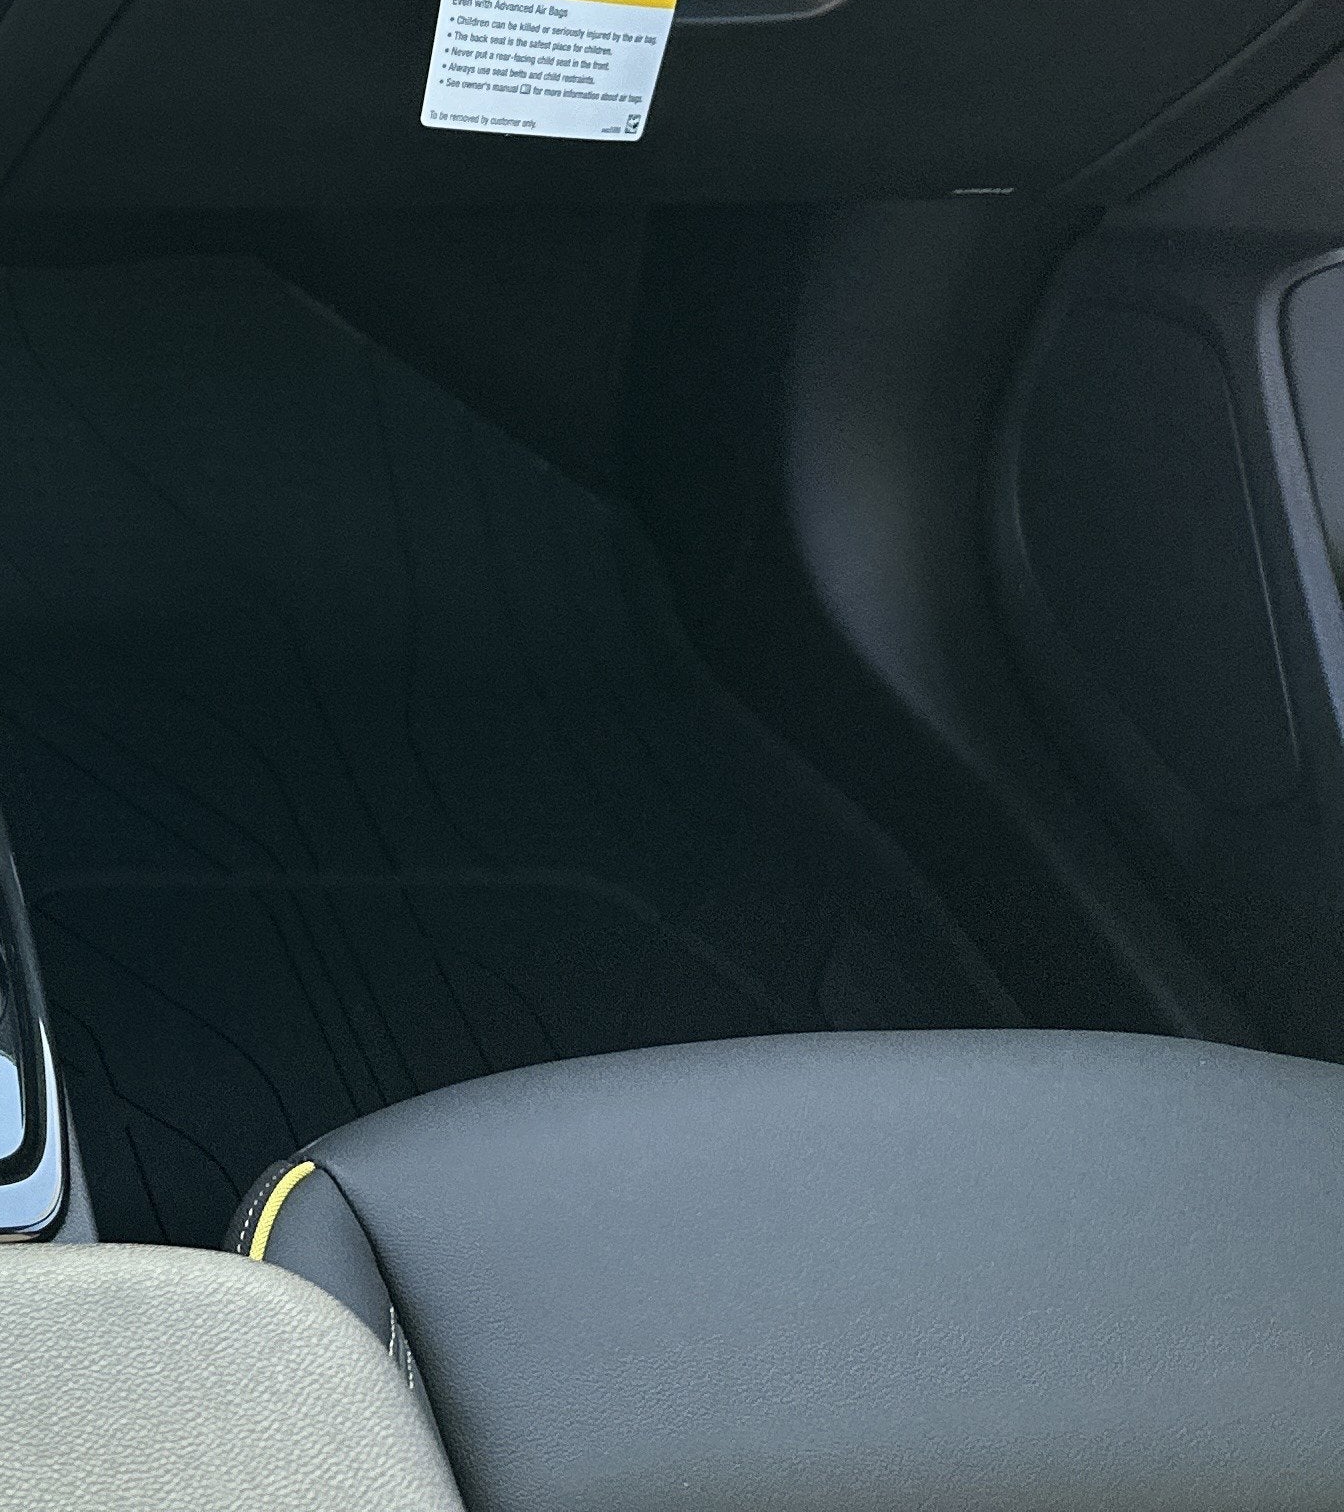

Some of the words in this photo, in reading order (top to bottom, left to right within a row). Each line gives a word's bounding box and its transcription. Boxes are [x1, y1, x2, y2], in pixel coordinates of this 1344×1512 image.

[494, 0, 534, 14] Advanced
[535, 4, 548, 15] Air
[548, 5, 568, 19] Bags
[456, 15, 490, 28] Children
[492, 21, 506, 29] can
[507, 21, 518, 30] be
[520, 22, 541, 33] killed
[552, 27, 585, 40] seriously
[454, 30, 469, 42] The
[469, 33, 488, 43] back
[529, 39, 552, 50] safest
[552, 42, 572, 53] place
[451, 46, 474, 58] Never
[475, 50, 488, 60] put
[495, 52, 536, 66] rear-facing
[537, 55, 556, 66] child
[448, 62, 476, 75] Always
[508, 68, 528, 79] belts
[445, 77, 461, 88] See
[492, 84, 519, 94] manual
[438, 111, 449, 121] be
[449, 113, 480, 124] removed
[490, 117, 522, 127] customer
